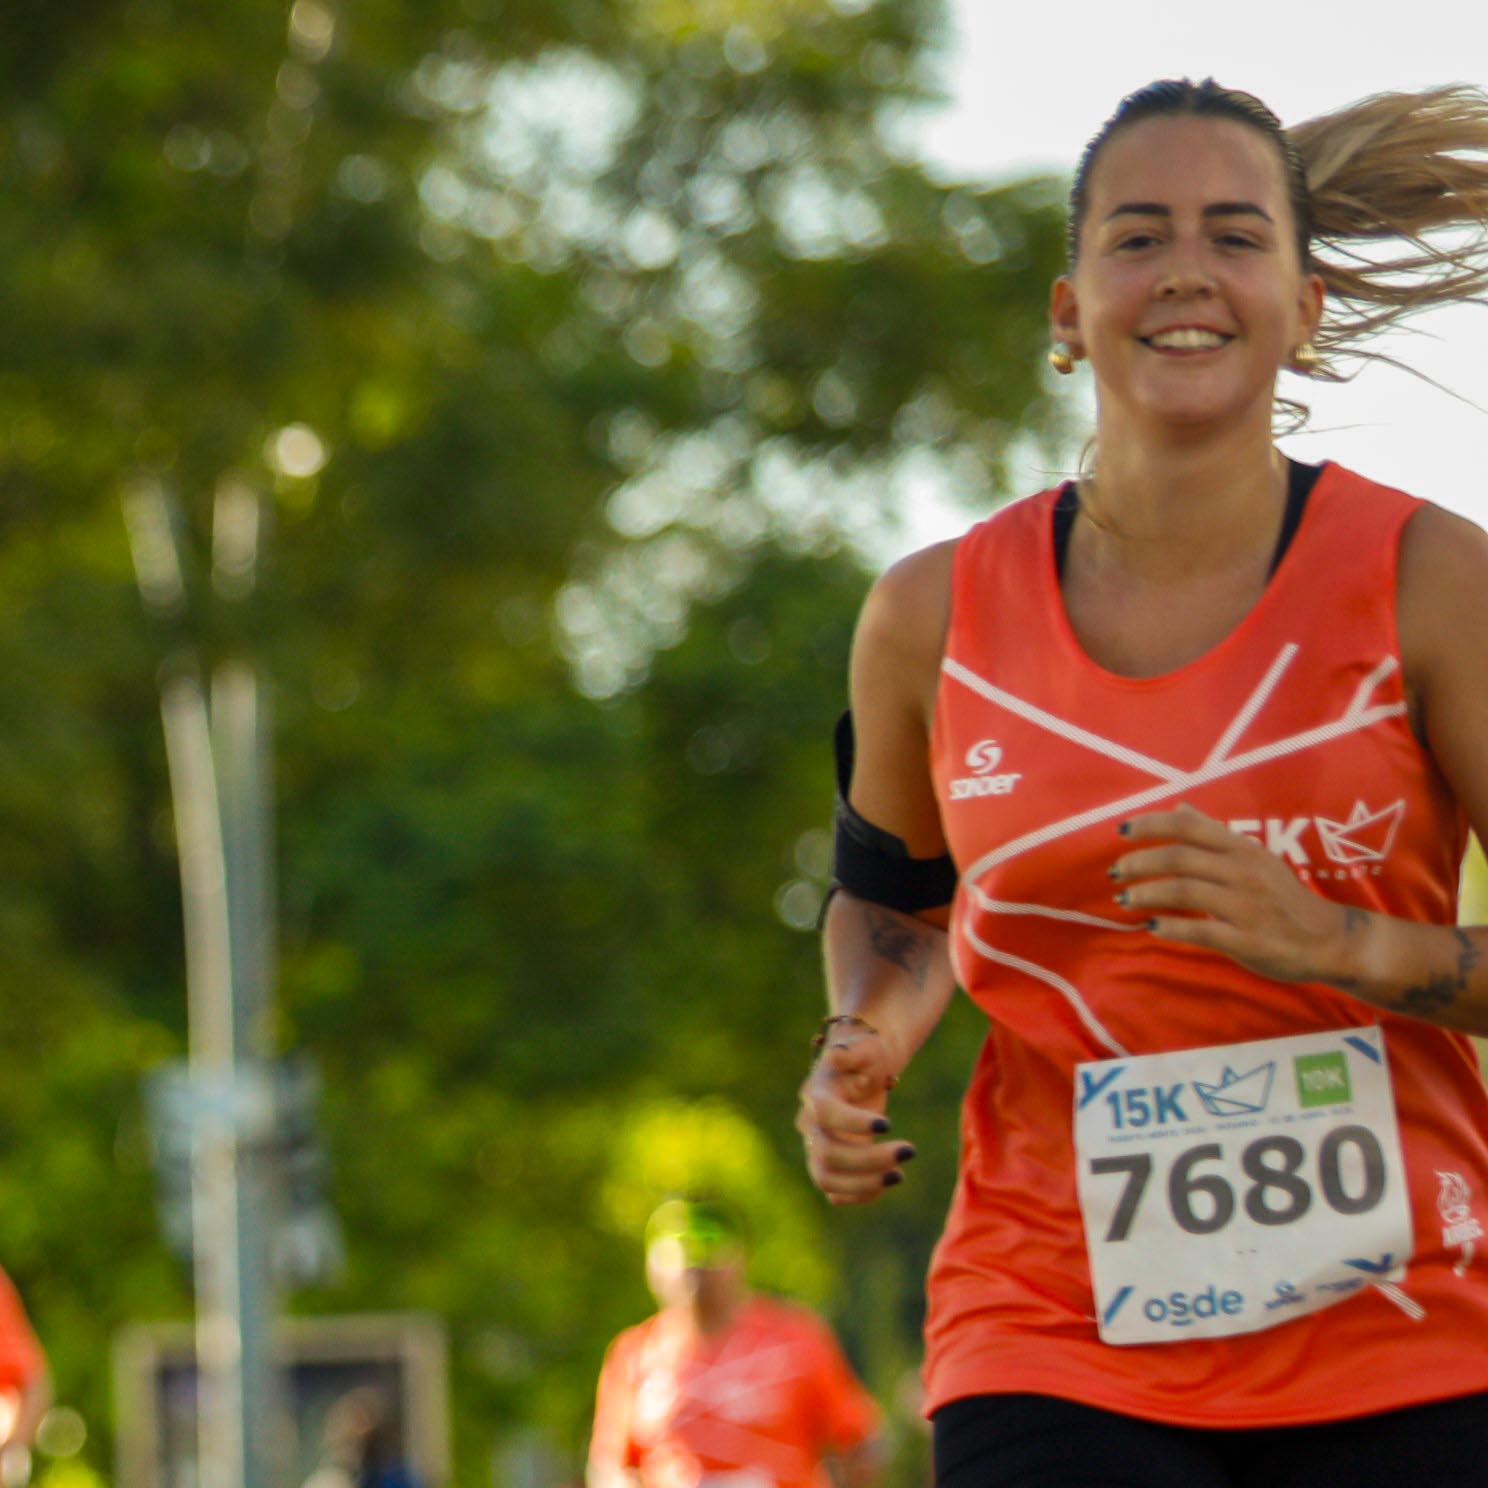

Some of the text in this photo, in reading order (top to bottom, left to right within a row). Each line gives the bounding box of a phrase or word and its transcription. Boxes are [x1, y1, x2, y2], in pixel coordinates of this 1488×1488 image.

[1226, 816, 1311, 865] 5K
[1106, 1083, 1190, 1129] 15K
[1090, 1124, 1387, 1243] 7680
[1144, 1284, 1244, 1326] osde
